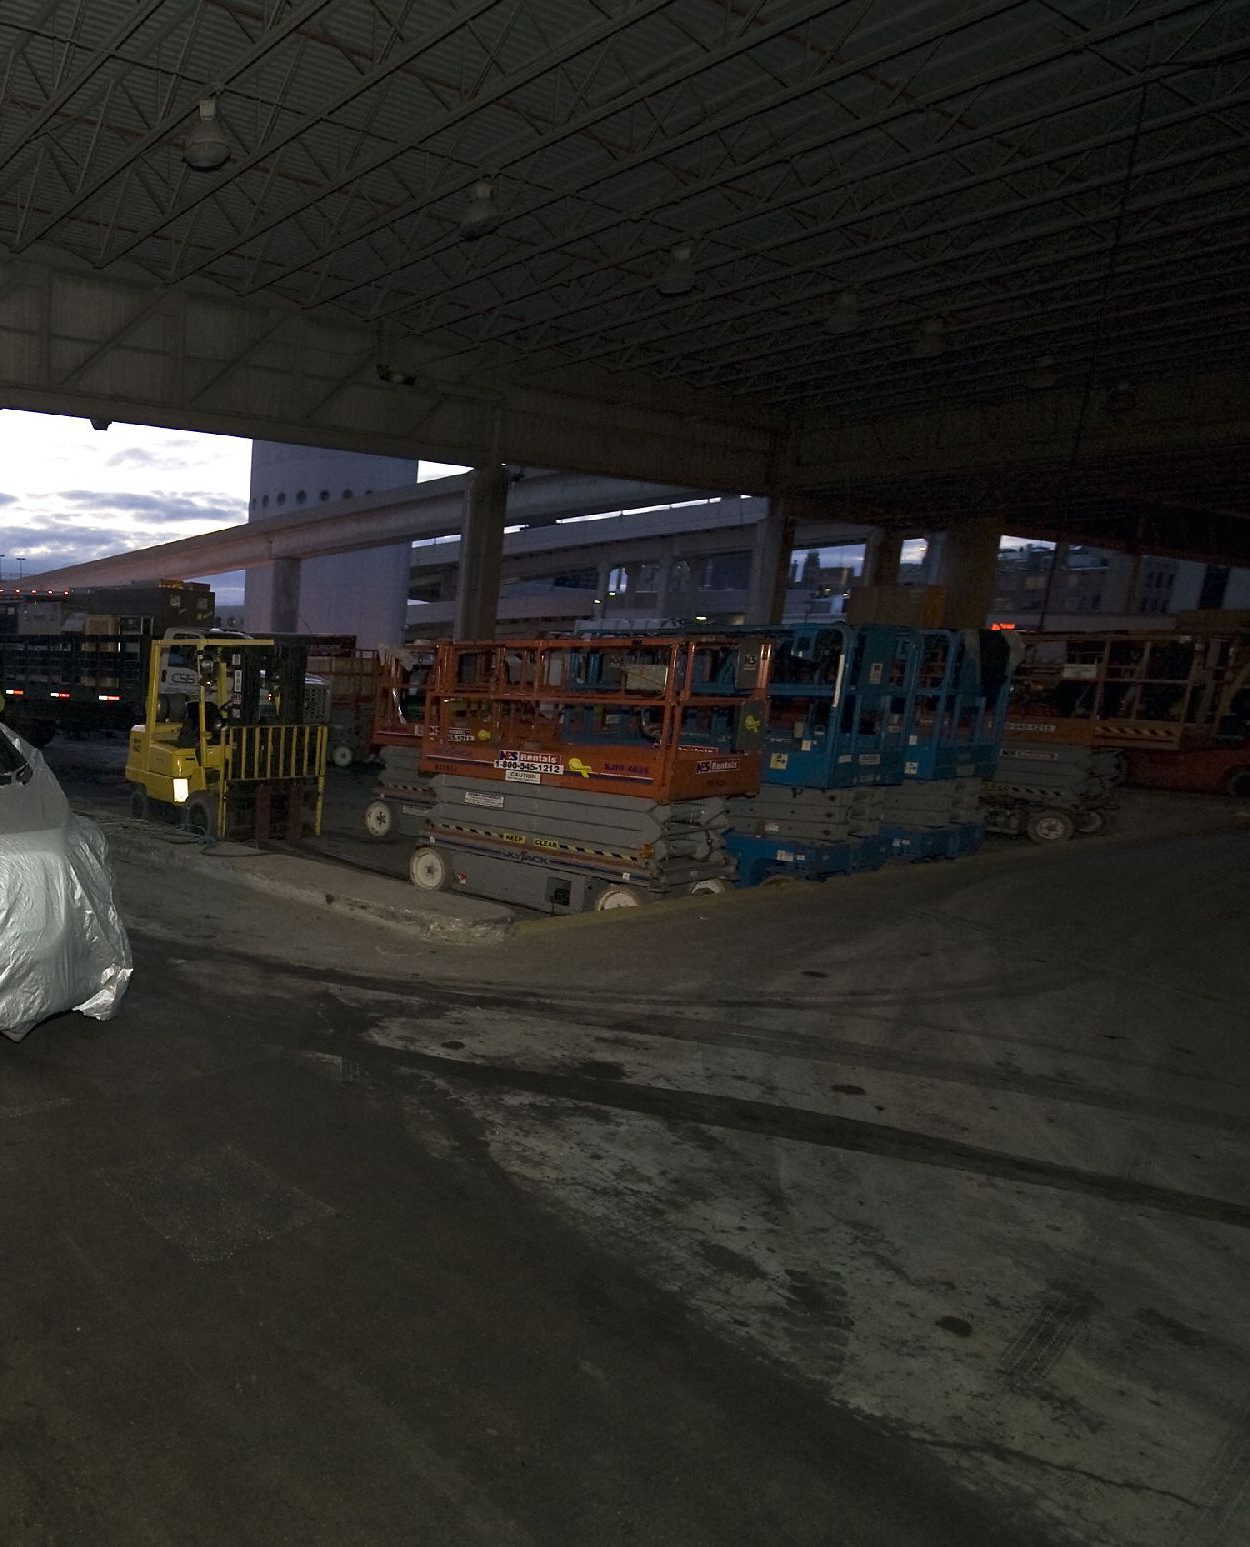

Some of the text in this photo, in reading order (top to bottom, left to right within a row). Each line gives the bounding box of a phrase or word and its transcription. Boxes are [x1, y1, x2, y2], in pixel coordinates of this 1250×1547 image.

[519, 753, 557, 763] Rentals
[495, 760, 560, 773] 1-800-545-1212
[534, 839, 557, 848] CLEAR
